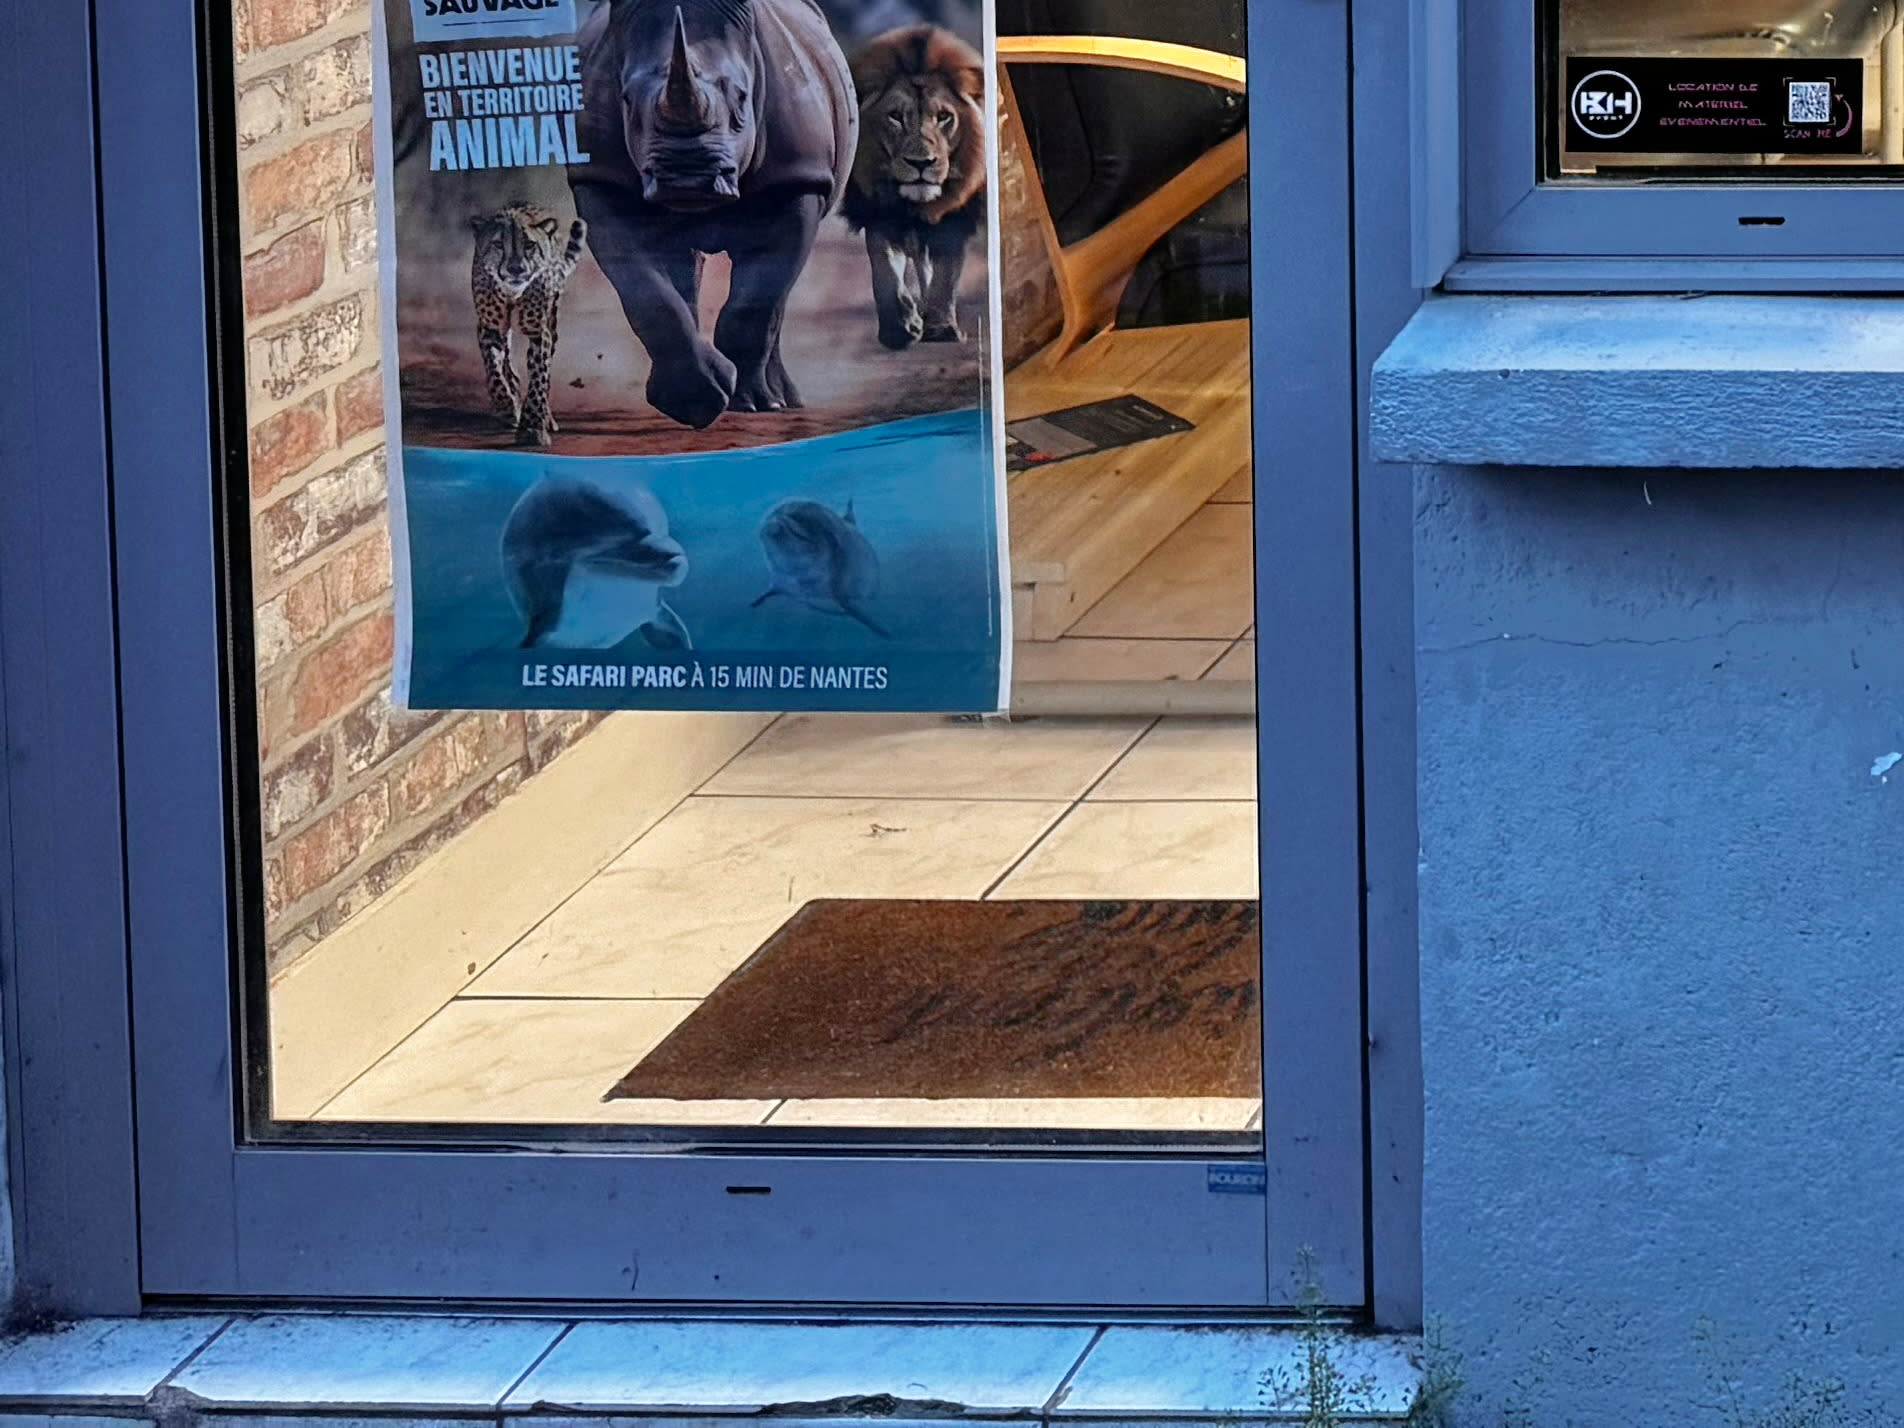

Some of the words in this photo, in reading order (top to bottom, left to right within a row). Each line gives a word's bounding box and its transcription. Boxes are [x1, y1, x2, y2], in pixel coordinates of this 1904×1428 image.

[419, 46, 582, 88] BIENVENUE
[424, 91, 453, 118] EN
[459, 84, 584, 116] TERRITOIRE
[1668, 83, 1735, 92] LOCATION
[430, 114, 591, 171] ANIMAL
[1784, 129, 1811, 139] SCAN
[1816, 130, 1832, 139] ME
[522, 665, 548, 687] LE
[551, 665, 626, 687] SAFARI
[631, 666, 687, 687] PARC
[691, 661, 704, 687] À
[710, 666, 729, 688] 15
[735, 666, 773, 688] MIN
[779, 666, 805, 689] DE
[810, 667, 889, 689] NANTES
